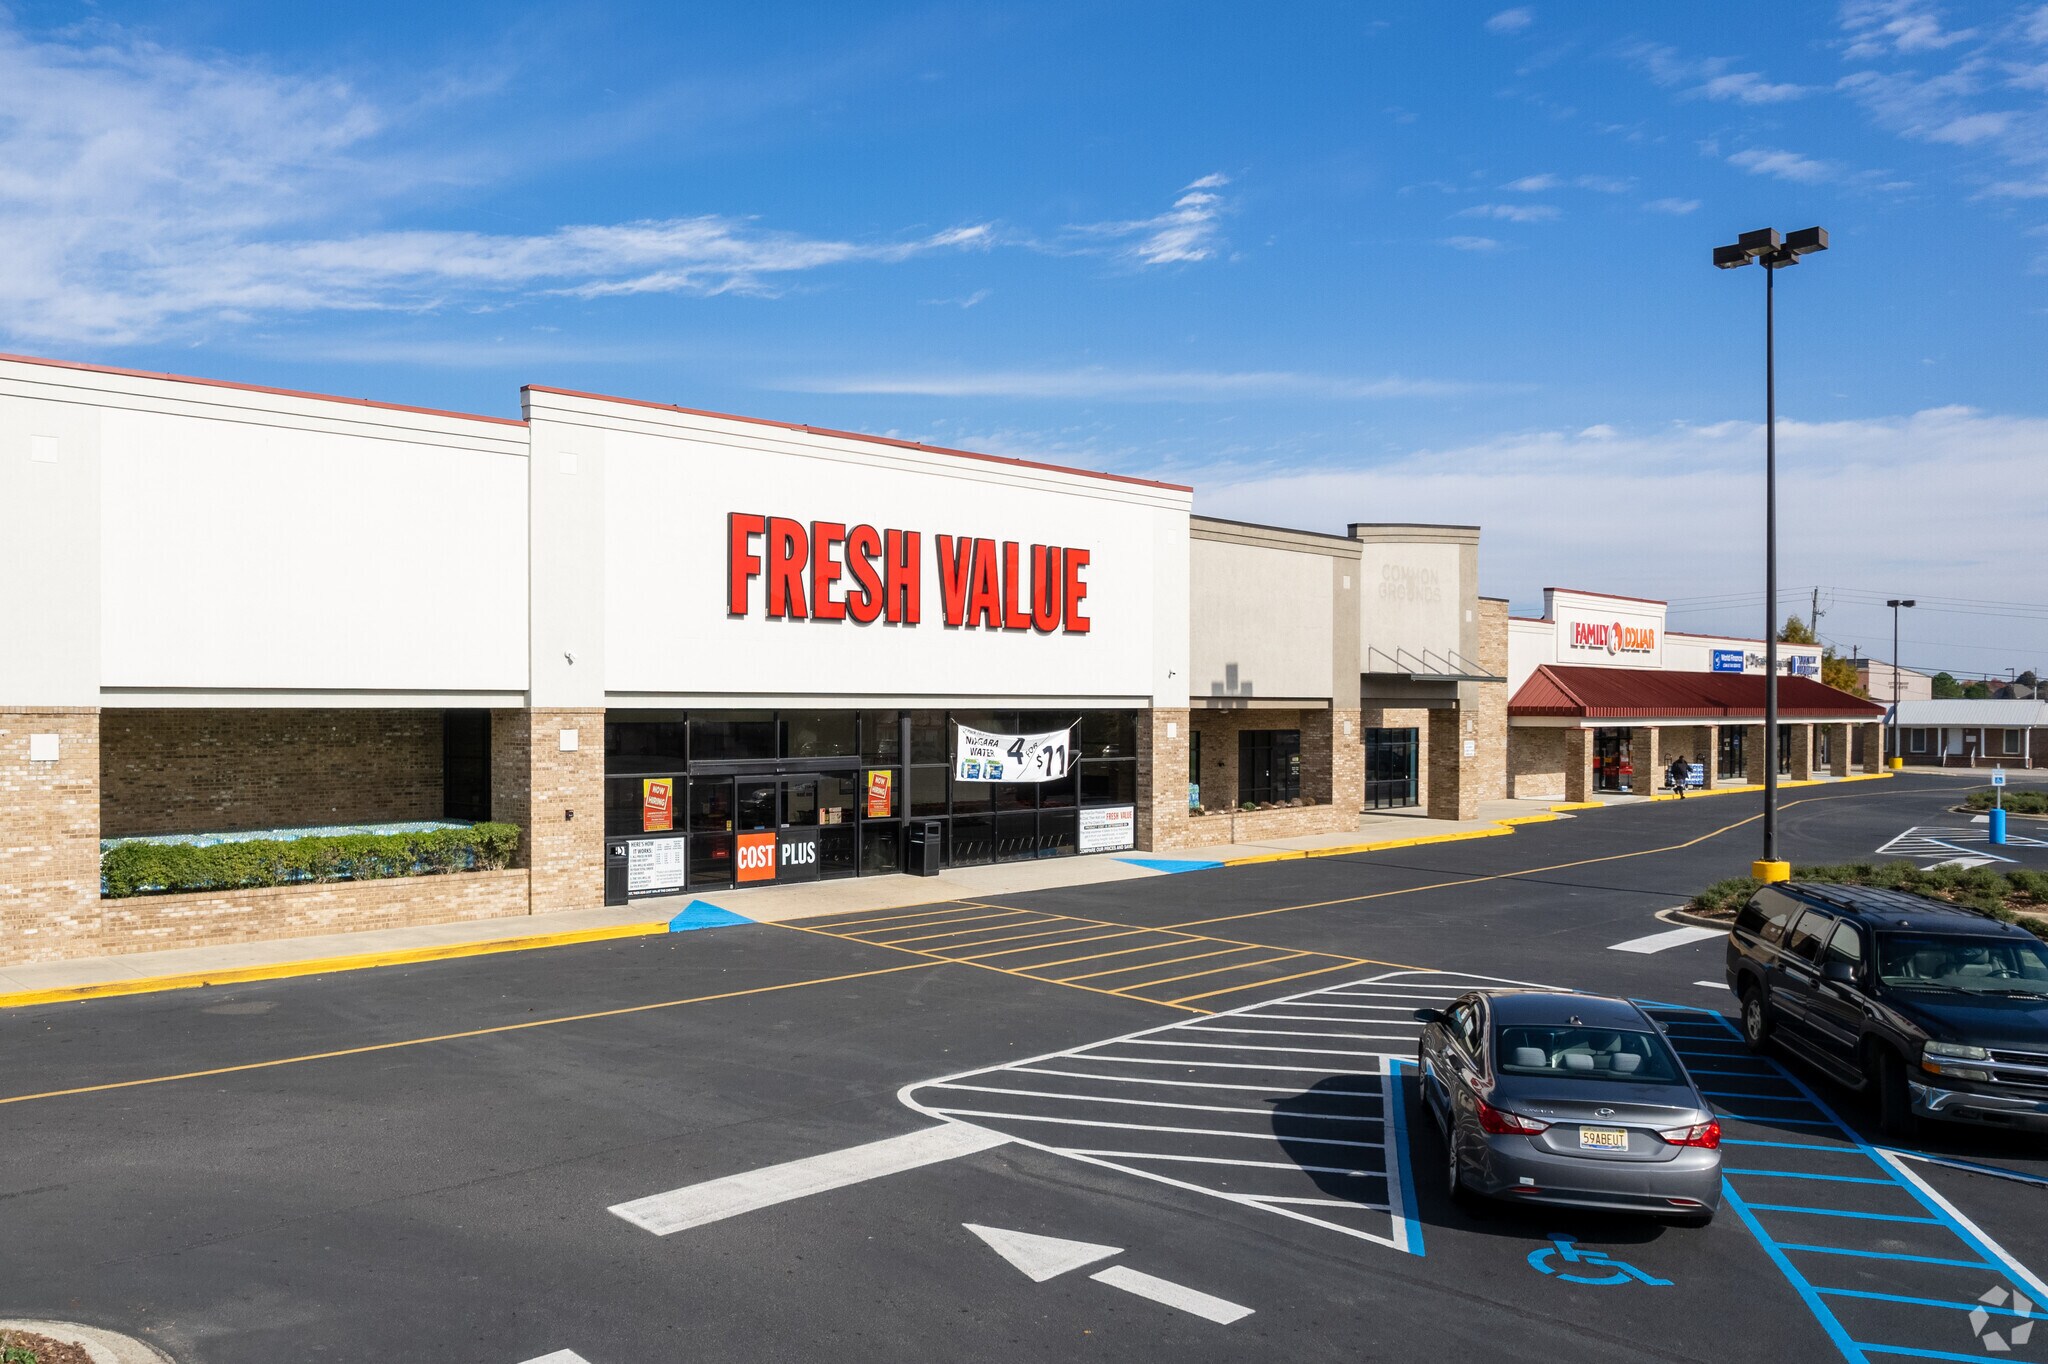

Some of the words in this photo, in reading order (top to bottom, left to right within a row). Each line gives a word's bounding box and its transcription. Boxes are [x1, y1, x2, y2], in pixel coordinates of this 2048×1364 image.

[727, 512, 921, 624] FRESH
[935, 533, 1090, 633] VALUE
[1382, 564, 1438, 584] COMMON
[1379, 582, 1440, 602] GROUNDS
[1575, 622, 1609, 646] FAMILY
[1624, 627, 1654, 649] DOLLAR
[965, 735, 999, 748] NIAGARA
[1007, 737, 1025, 765] 4
[1025, 742, 1038, 758] FOR
[969, 746, 996, 758] WATER
[652, 785, 666, 795] NOW
[1106, 812, 1119, 820] FRESH
[1121, 811, 1133, 819] VALUE
[738, 844, 775, 869] COST
[782, 841, 816, 866] PLUS
[1583, 1132, 1624, 1147] 59ABEUT
